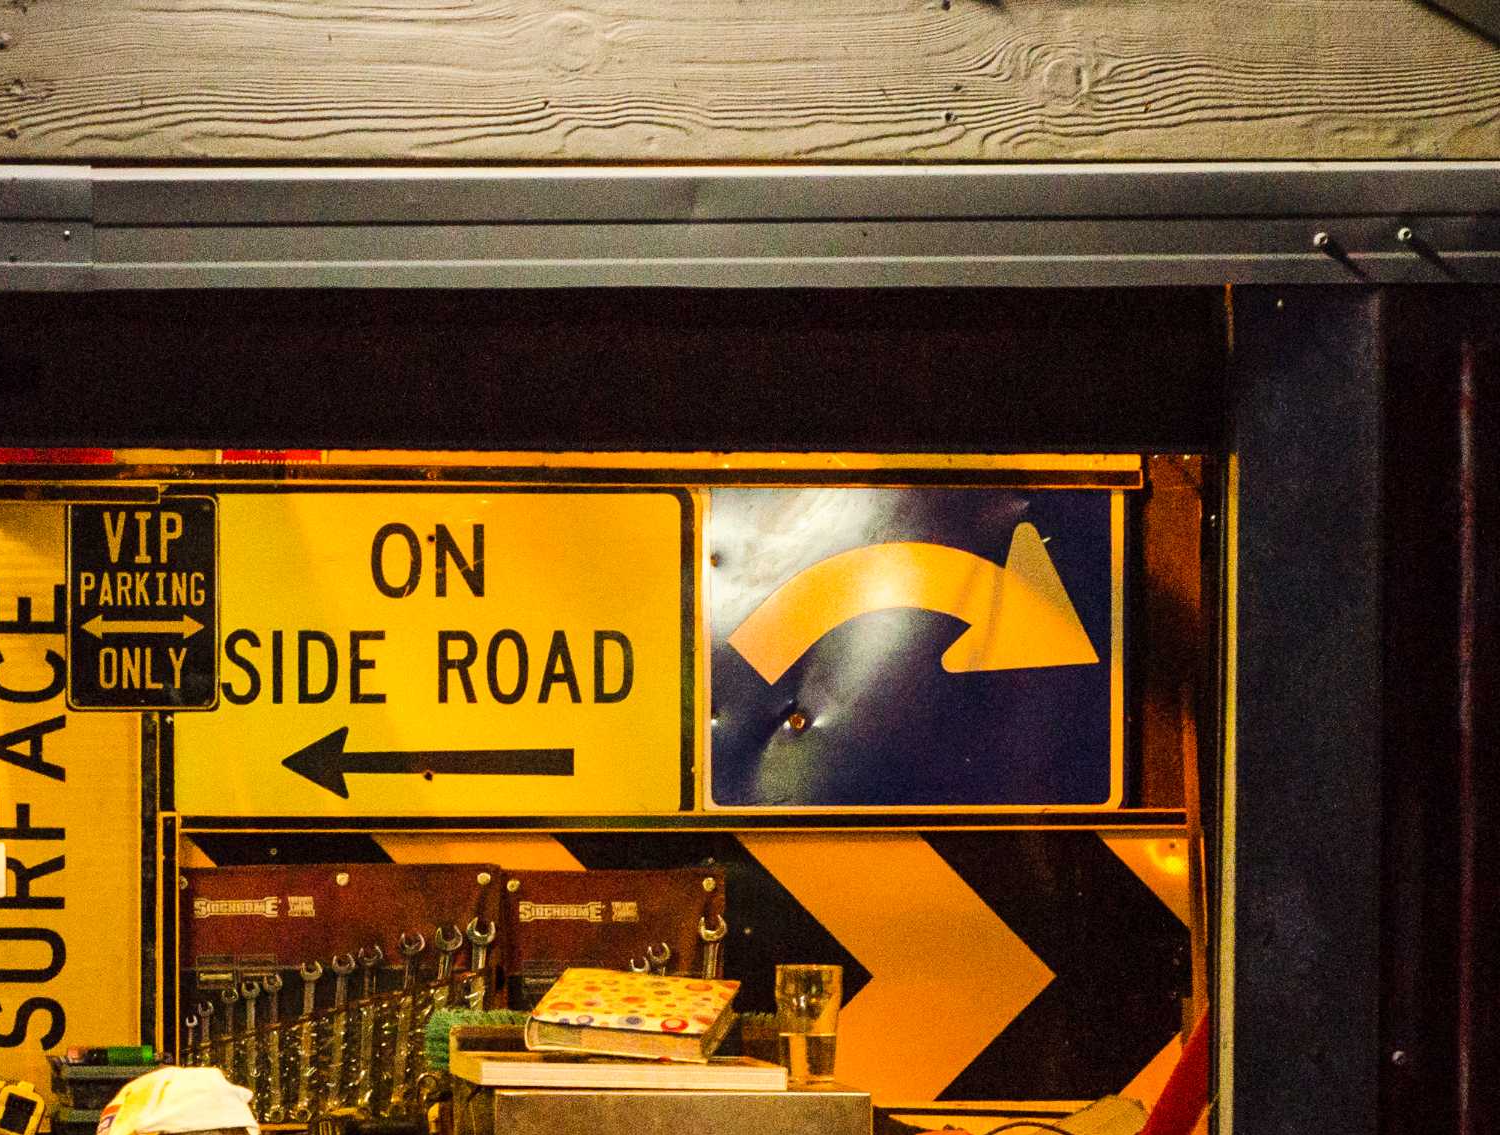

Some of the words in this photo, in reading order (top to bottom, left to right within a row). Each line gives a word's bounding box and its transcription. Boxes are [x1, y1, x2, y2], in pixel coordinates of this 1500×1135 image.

[103, 511, 184, 564] VIP
[371, 522, 485, 599] ON
[79, 571, 206, 607] PARKING
[99, 647, 188, 690] ONLY
[221, 628, 387, 706] SIDE
[438, 628, 635, 705] ROAD
[519, 901, 602, 922] SIDCHROME
